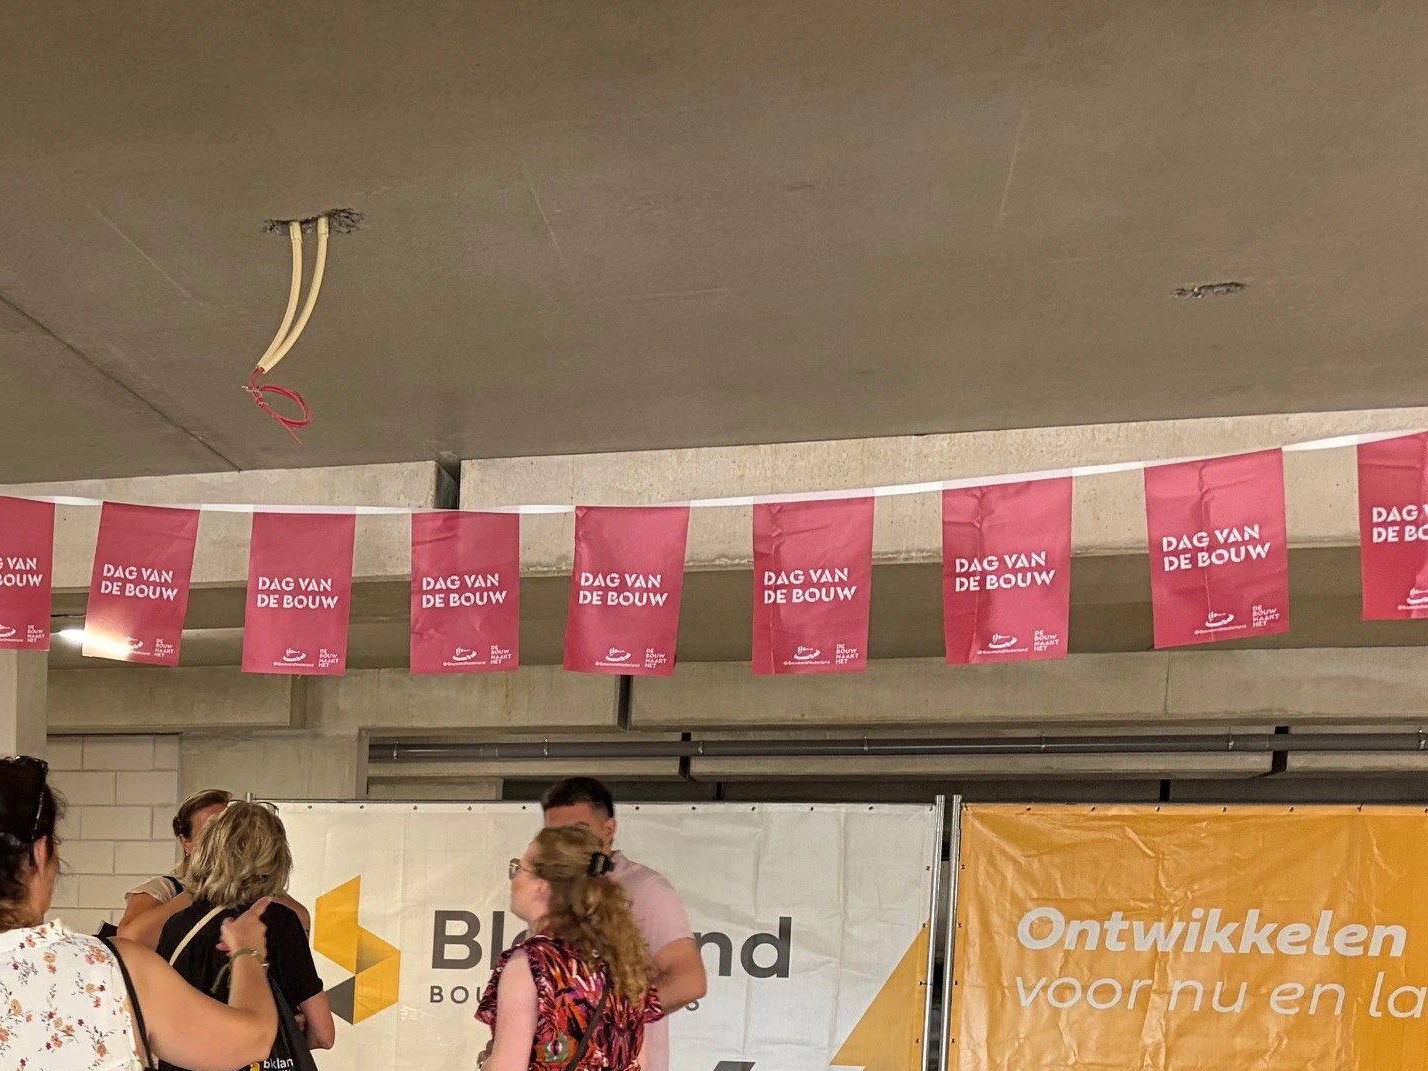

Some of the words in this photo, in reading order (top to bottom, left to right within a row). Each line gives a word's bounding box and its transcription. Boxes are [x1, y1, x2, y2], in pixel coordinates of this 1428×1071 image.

[1372, 504, 1419, 523] DAG
[1162, 531, 1210, 552] DAG
[1214, 524, 1260, 544] VAN
[1372, 526, 1400, 543] DE
[7, 557, 37, 570] VAN
[955, 556, 999, 573] DAG
[1003, 551, 1046, 569] VAN
[1163, 554, 1192, 572] DE
[1197, 542, 1271, 568] BOUW
[103, 563, 137, 579] DAG
[141, 567, 173, 584] VAN
[422, 575, 461, 591] DAG
[464, 573, 499, 588] VAN
[581, 572, 620, 587] DAG
[624, 573, 662, 588] VAN
[764, 570, 805, 585] DAG
[808, 567, 848, 583] VAN
[955, 576, 980, 592] DE
[986, 569, 1056, 590] BOUW
[101, 580, 122, 595] DE
[125, 583, 178, 601] BOUW
[258, 576, 295, 591] DAG
[298, 577, 332, 591] VAN
[257, 594, 279, 607] DE
[283, 594, 339, 609] BOUW
[422, 593, 445, 608] DE
[449, 590, 507, 607] BOUW
[578, 590, 603, 605] DE
[607, 591, 669, 607] BOUW
[764, 589, 787, 604] DE
[792, 585, 857, 603] BOUW
[1017, 906, 1408, 957] Ontwikkelen
[1015, 975, 1152, 1011] voor
[1168, 978, 1248, 1014] nu
[1269, 981, 1346, 1017] en
